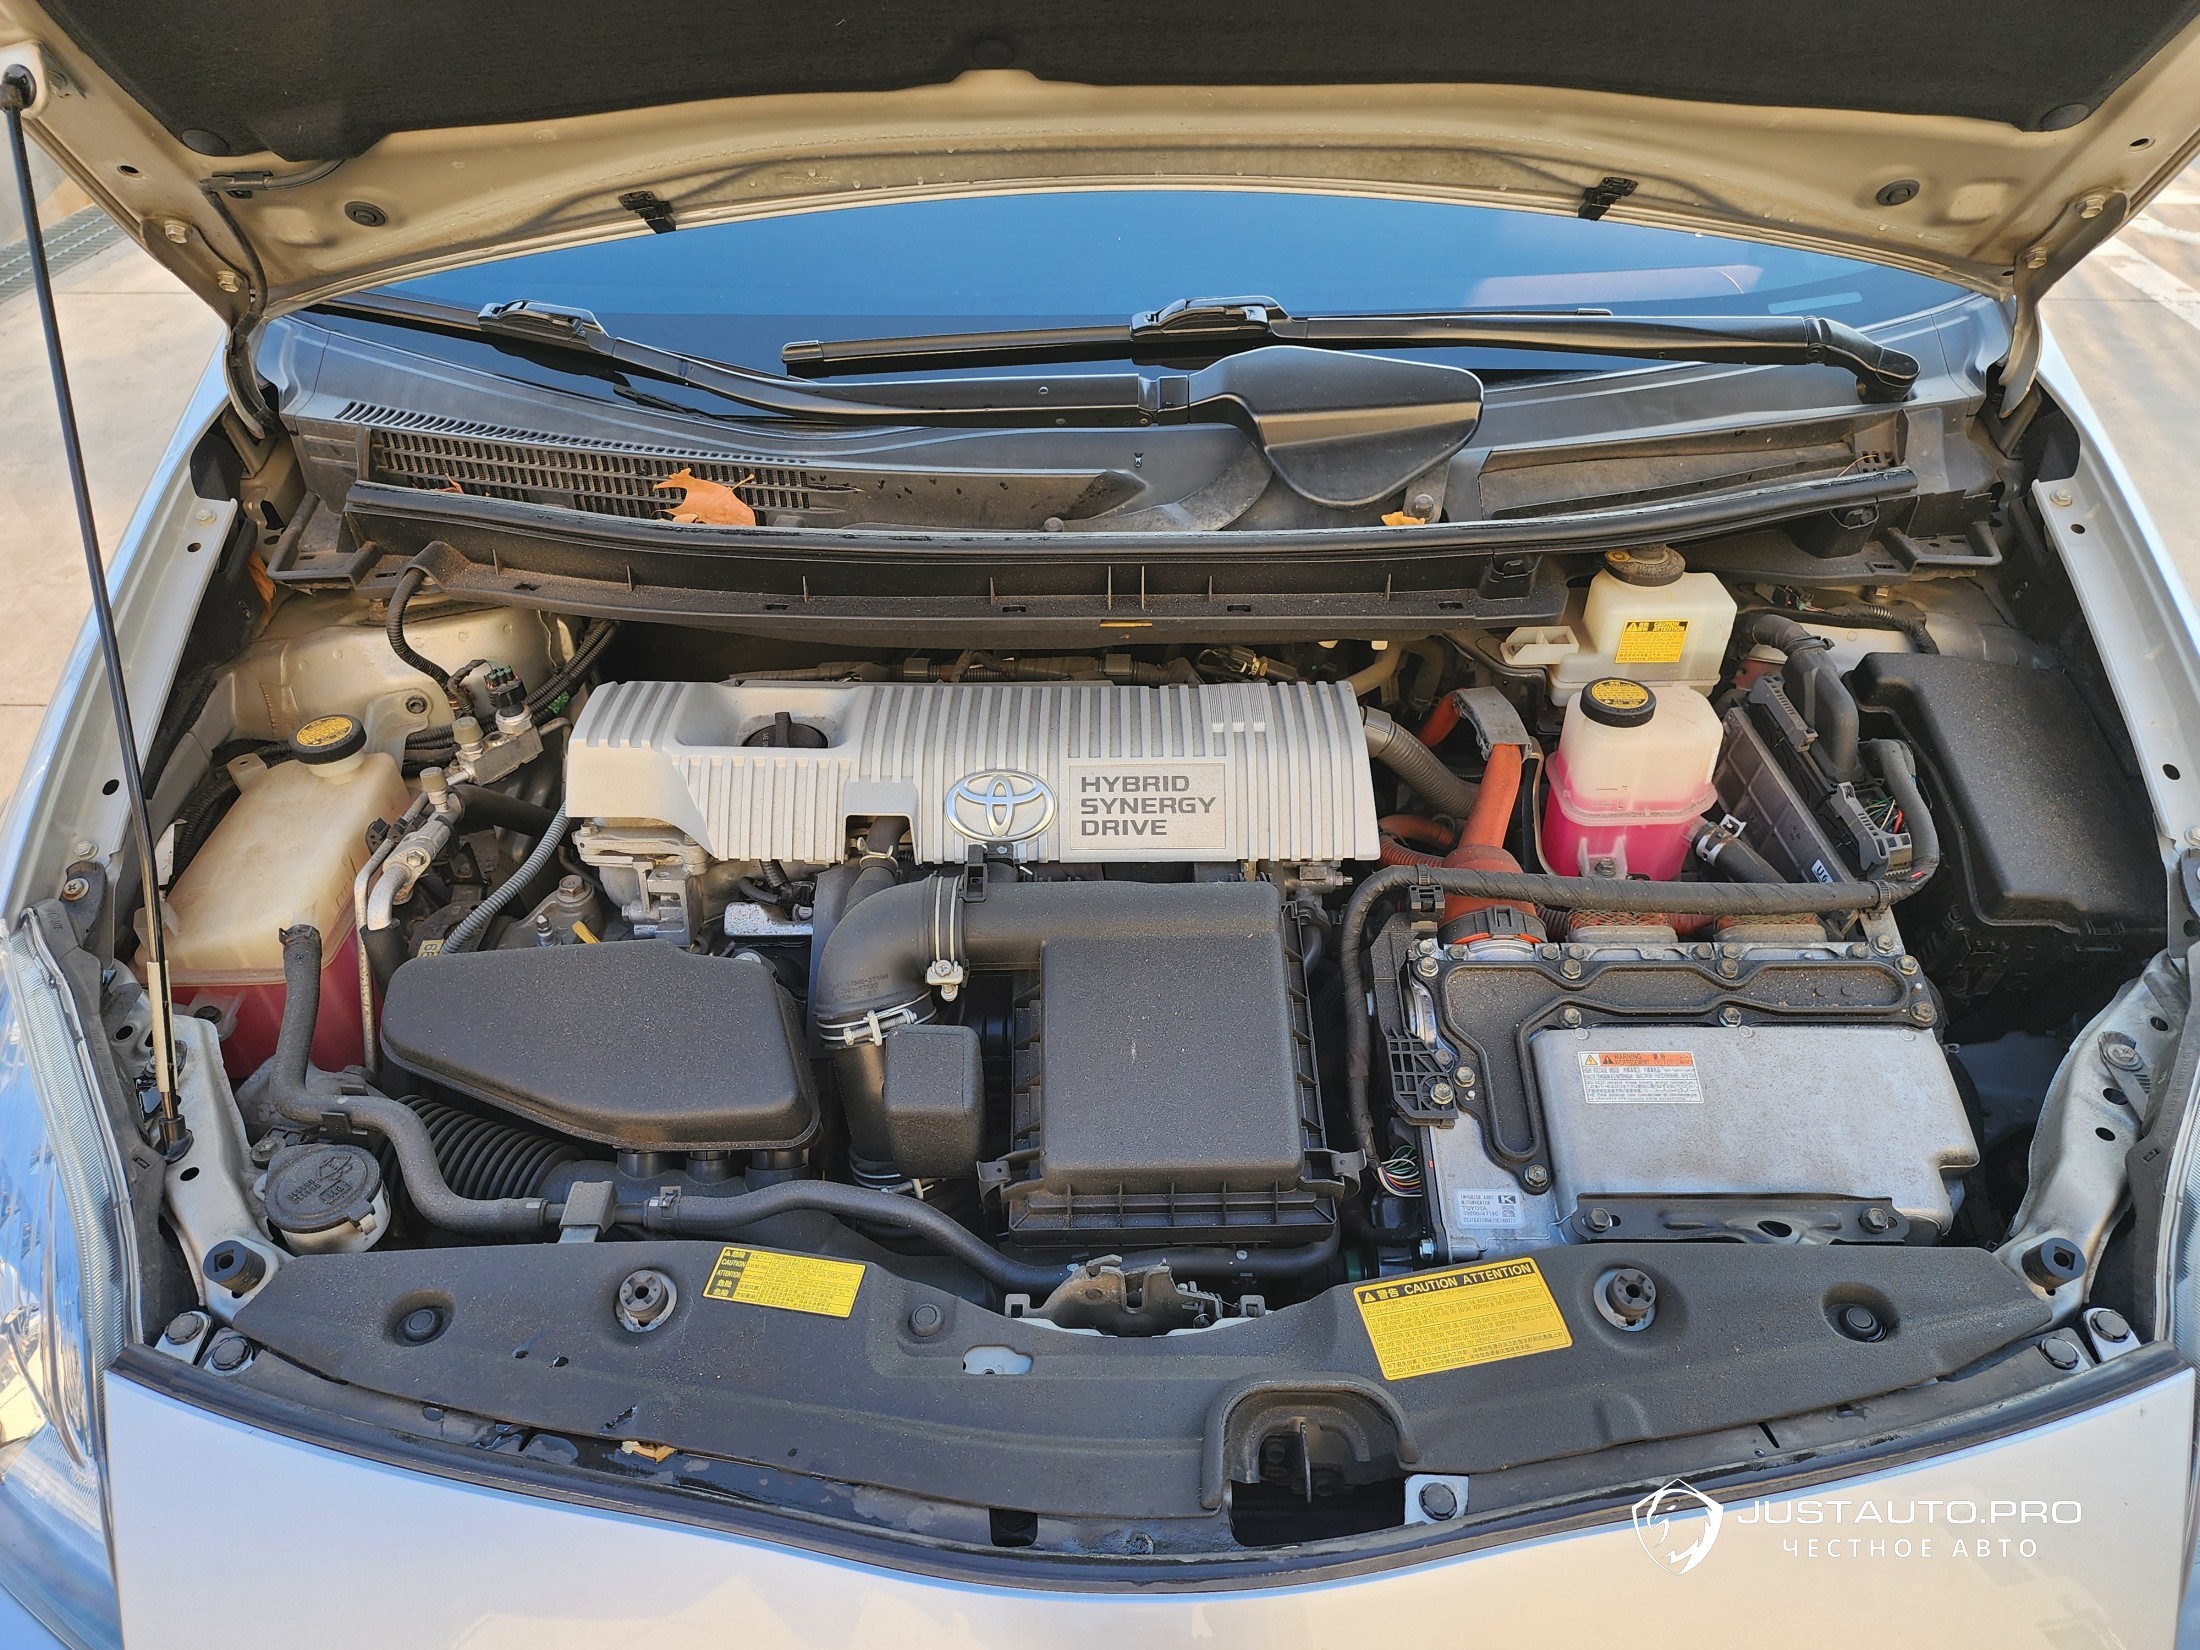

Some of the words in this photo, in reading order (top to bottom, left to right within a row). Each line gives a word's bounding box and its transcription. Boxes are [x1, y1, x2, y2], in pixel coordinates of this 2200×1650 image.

[1081, 775, 1190, 793] HYBRID
[1081, 797, 1217, 815] SYNERGY
[1081, 819, 1168, 836] DRIVE
[721, 1258, 747, 1268] CAUTION
[716, 1269, 742, 1279] ATTENTION
